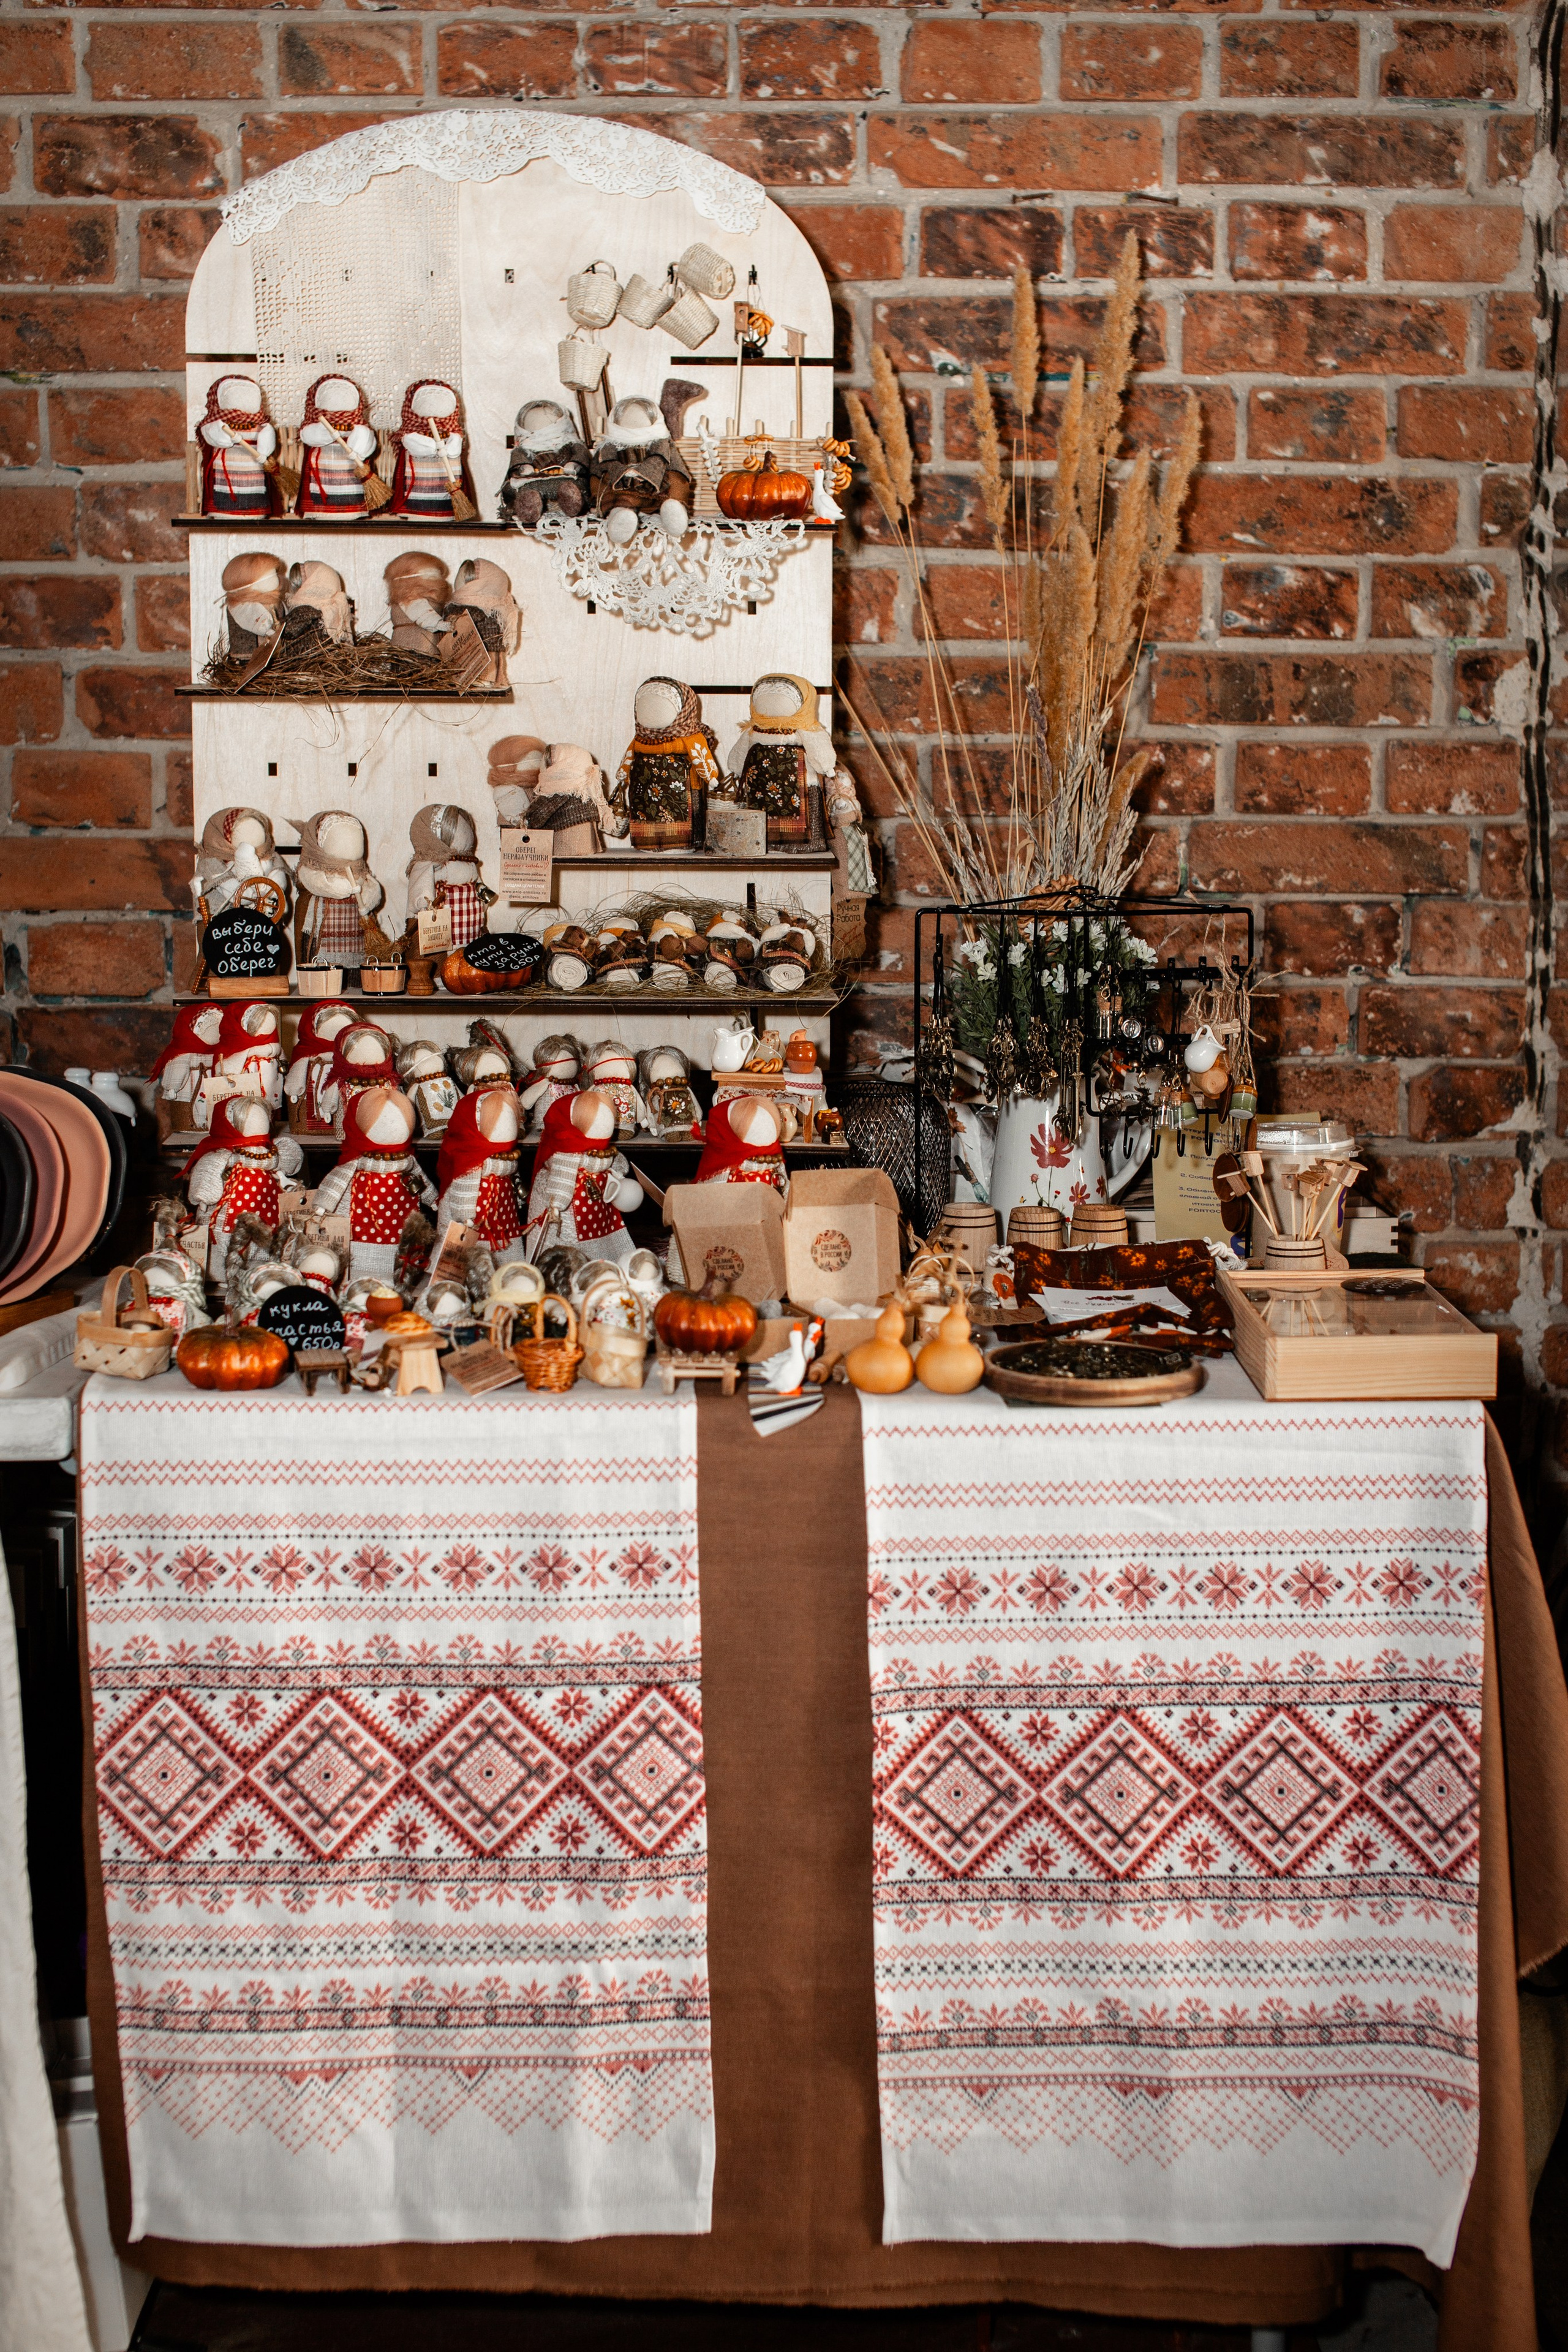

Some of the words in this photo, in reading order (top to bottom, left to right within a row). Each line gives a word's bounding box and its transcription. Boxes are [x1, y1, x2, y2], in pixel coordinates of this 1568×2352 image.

[504, 861, 521, 870] Сделано
[837, 904, 859, 914] Ручная
[837, 914, 860, 922] Работа
[225, 937, 264, 954] себе
[468, 944, 496, 960] кто
[475, 950, 503, 967] пути
[494, 957, 510, 968] за
[510, 942, 539, 960] рулём
[307, 1233, 330, 1242] РЕГИНЯ
[180, 1240, 205, 1250] ЧАСТЬЯ
[270, 1301, 329, 1319] кукла
